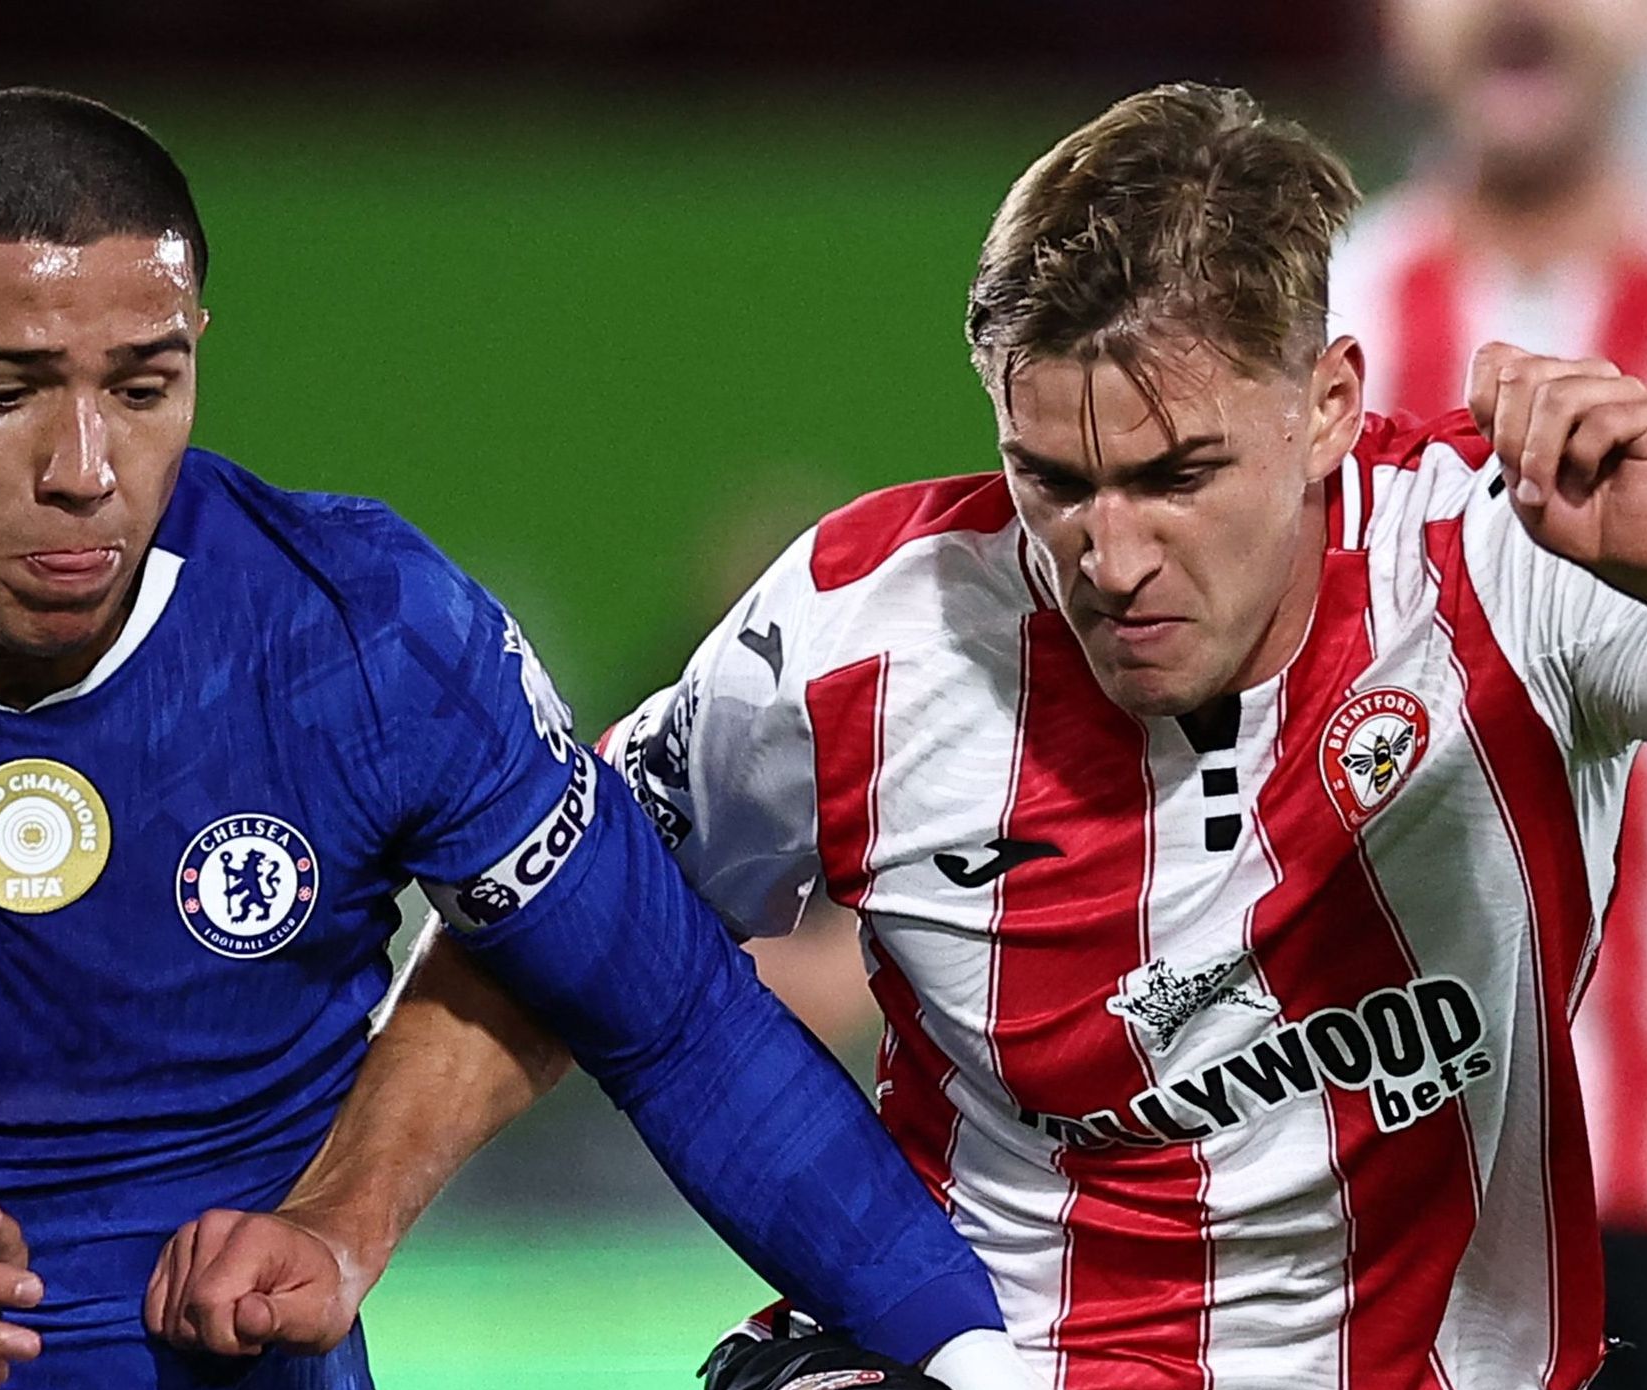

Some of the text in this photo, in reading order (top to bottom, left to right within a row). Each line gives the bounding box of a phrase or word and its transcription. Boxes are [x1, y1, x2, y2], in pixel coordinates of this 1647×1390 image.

[1329, 694, 1416, 750] BRENTFORD
[8, 773, 97, 852] CHAMPIONS
[199, 820, 291, 853] CHELSEA
[515, 746, 590, 886] Capta
[5, 877, 64, 899] FIFA
[204, 917, 296, 950] FOOTBALL CLUB
[1373, 1050, 1492, 1130] bets
